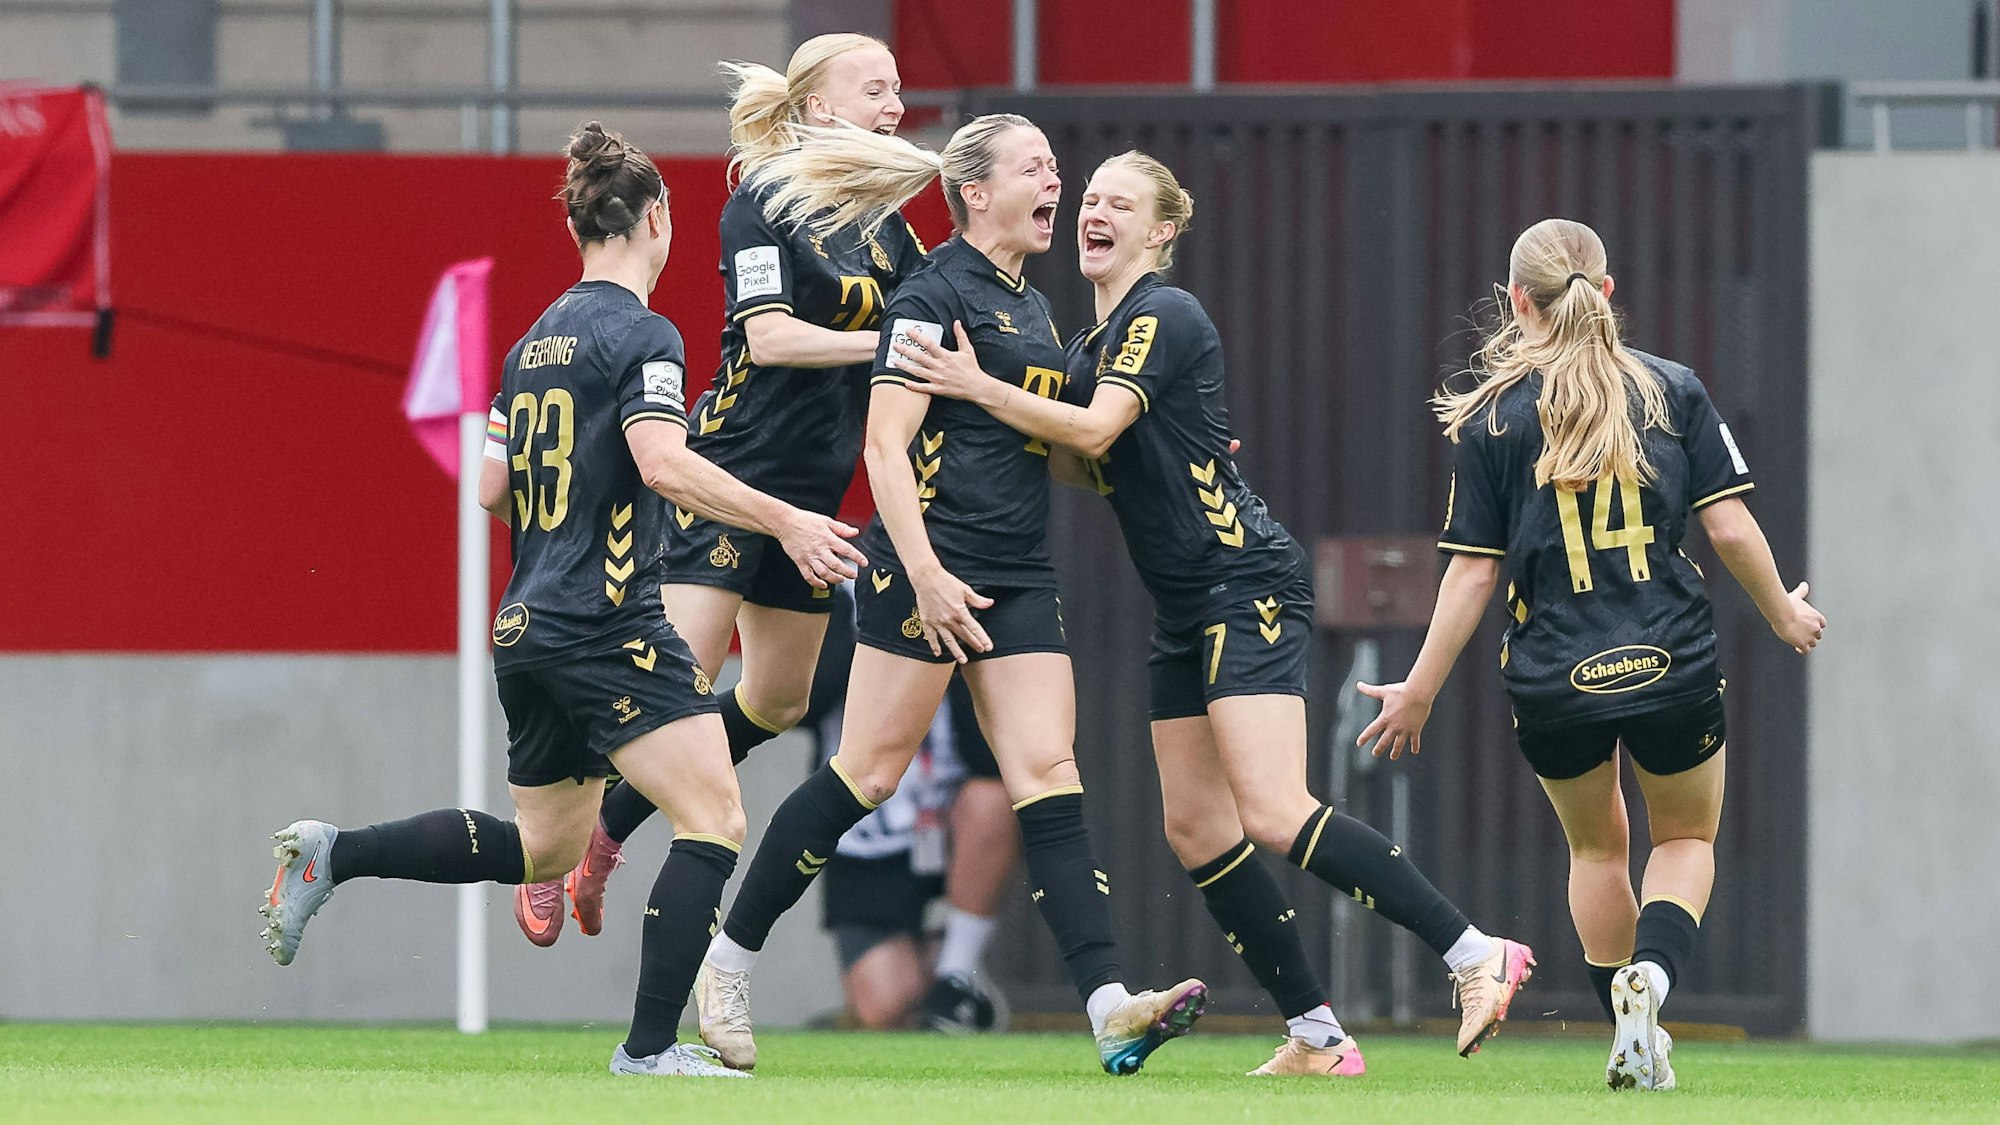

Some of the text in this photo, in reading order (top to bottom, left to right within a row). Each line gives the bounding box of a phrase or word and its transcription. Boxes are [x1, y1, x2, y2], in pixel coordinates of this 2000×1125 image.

[737, 261, 776, 277] Google
[744, 274, 770, 289] Pixel
[1121, 322, 1149, 368] DEVK
[510, 387, 575, 533] 33
[1536, 472, 1655, 594] 14
[1204, 622, 1227, 685] 7
[1581, 655, 1660, 682] Schaebens
